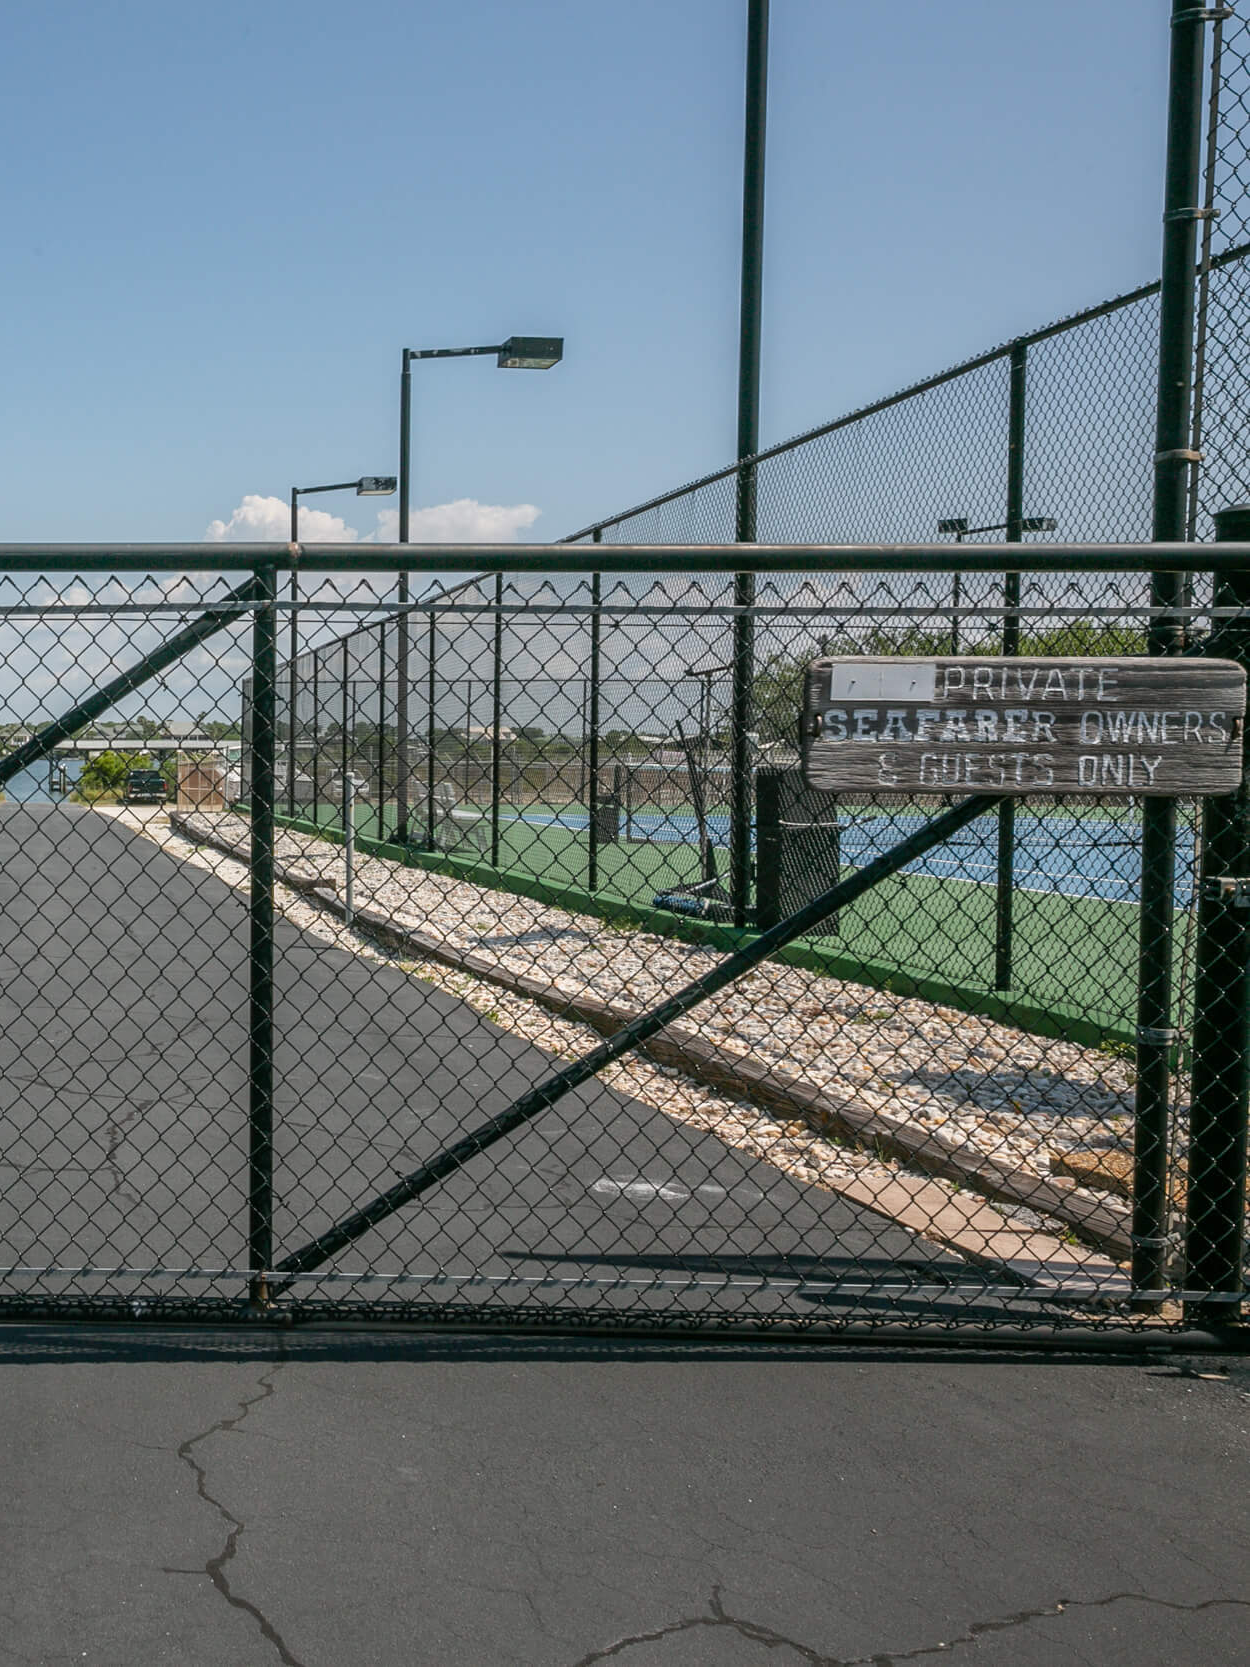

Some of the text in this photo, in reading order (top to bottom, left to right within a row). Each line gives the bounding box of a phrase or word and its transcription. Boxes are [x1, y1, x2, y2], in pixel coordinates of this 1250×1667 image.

[943, 667, 1120, 701] PRIVATE
[822, 707, 1228, 746] SEAFARER OWNERS
[919, 751, 1055, 787] GUESTS
[1077, 754, 1163, 788] ONLY
